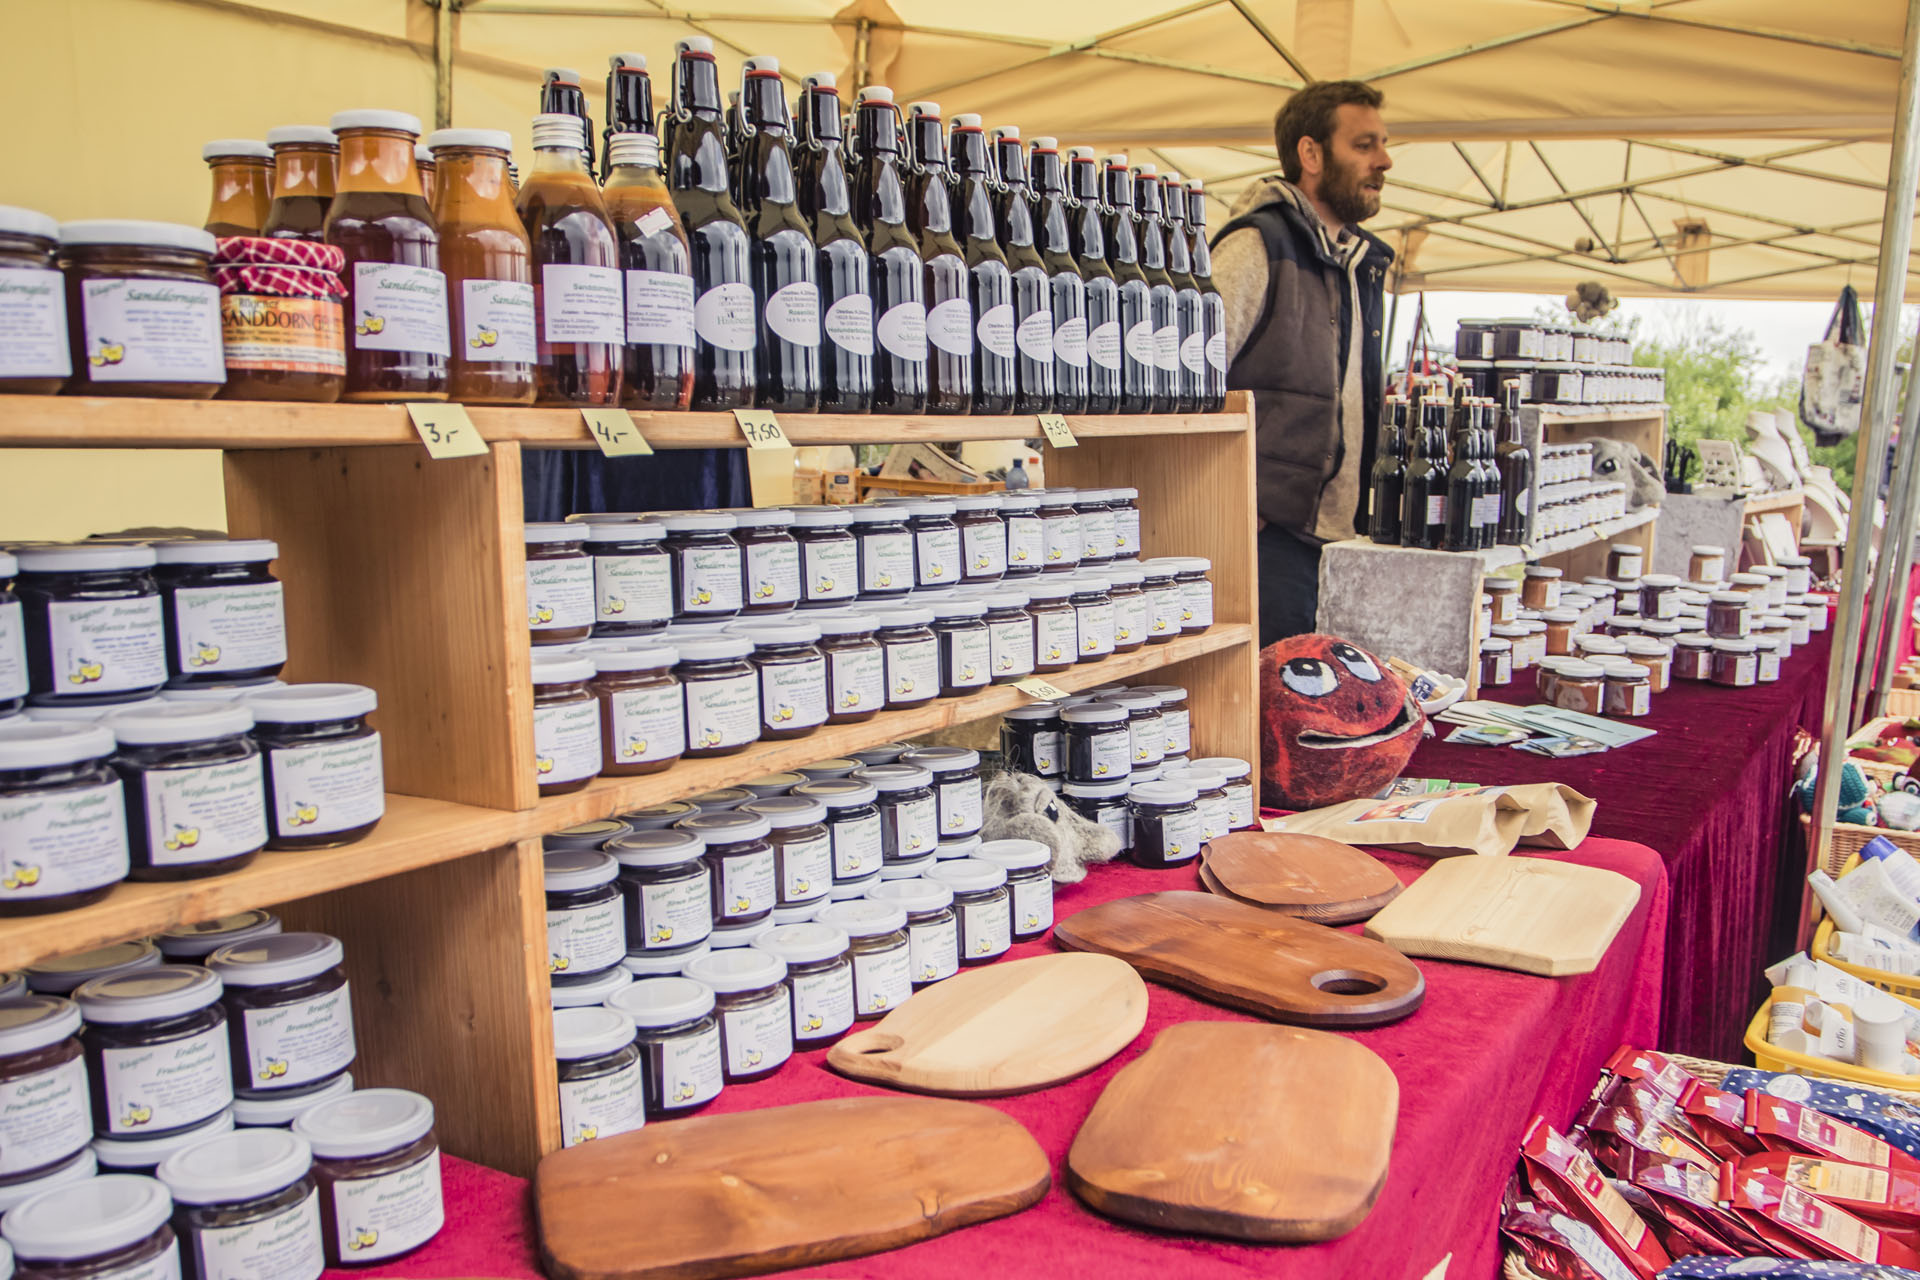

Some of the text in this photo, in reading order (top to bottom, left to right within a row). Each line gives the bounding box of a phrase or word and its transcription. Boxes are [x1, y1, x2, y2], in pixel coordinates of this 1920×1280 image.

[422, 421, 460, 444] 3,-
[596, 421, 630, 443] 4,-
[743, 421, 782, 442] 7,50
